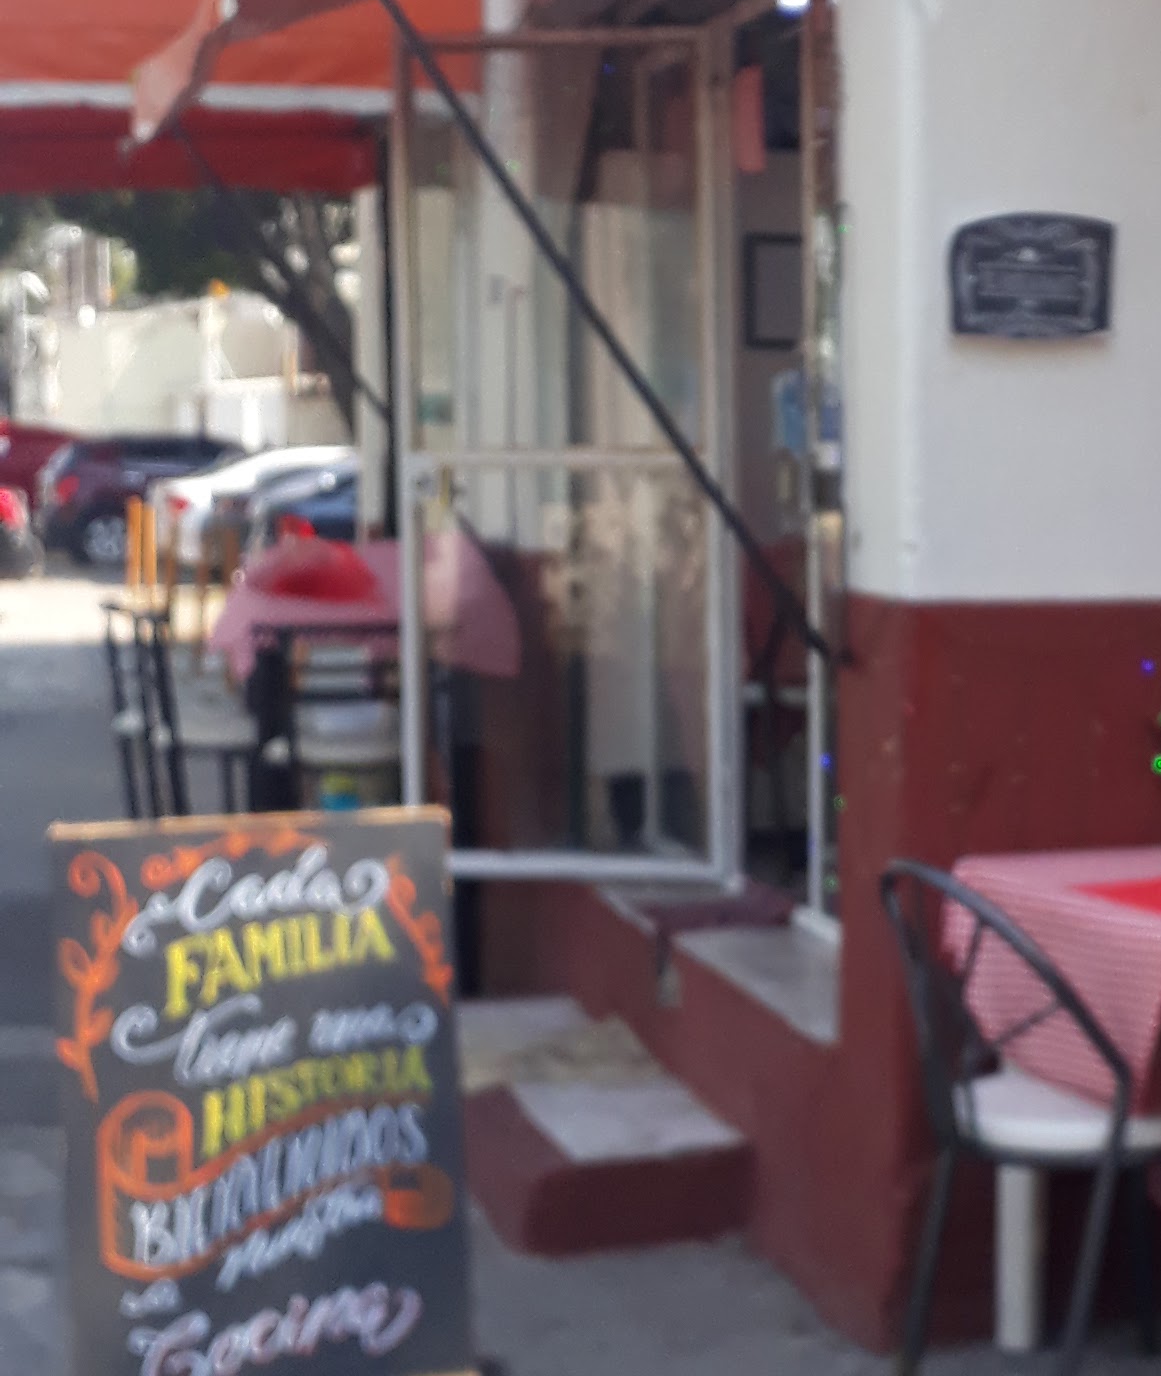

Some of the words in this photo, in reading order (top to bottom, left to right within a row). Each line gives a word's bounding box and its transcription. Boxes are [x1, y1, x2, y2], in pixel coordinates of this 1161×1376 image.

[122, 842, 389, 958] Cada
[164, 907, 396, 1020] FAMILIA
[201, 1044, 432, 1158] HISTORIA
